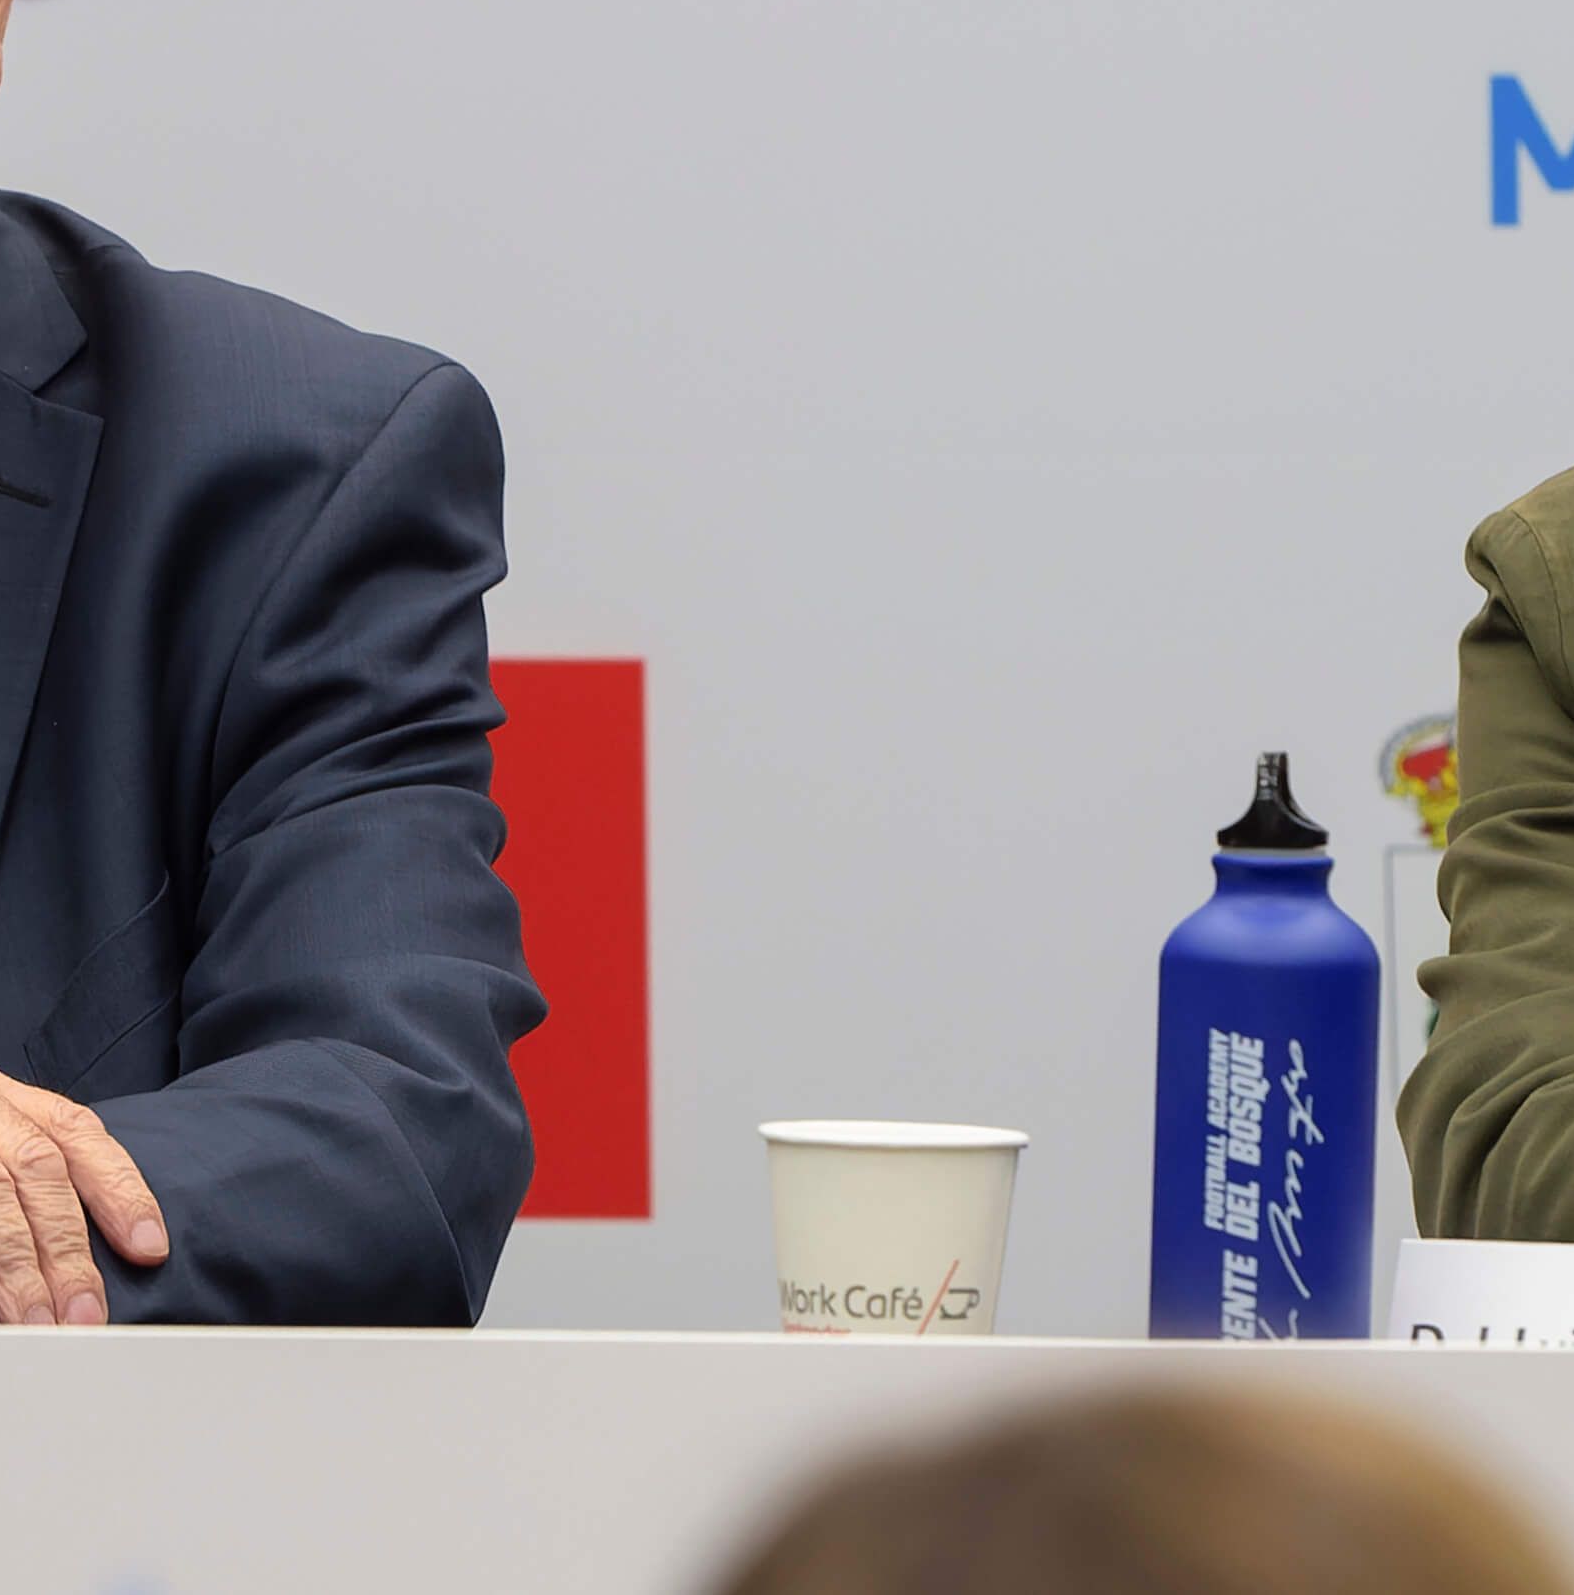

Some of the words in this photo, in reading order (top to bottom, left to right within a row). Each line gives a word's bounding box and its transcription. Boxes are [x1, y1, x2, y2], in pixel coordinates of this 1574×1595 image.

[1206, 1026, 1230, 1132] ACADEMY
[1227, 1030, 1272, 1167] BOSQUE
[1204, 1134, 1228, 1232] FOOTBALL
[1225, 1180, 1261, 1242] DEL
[843, 1283, 924, 1321] Café
[1221, 1248, 1259, 1342] ENTE
